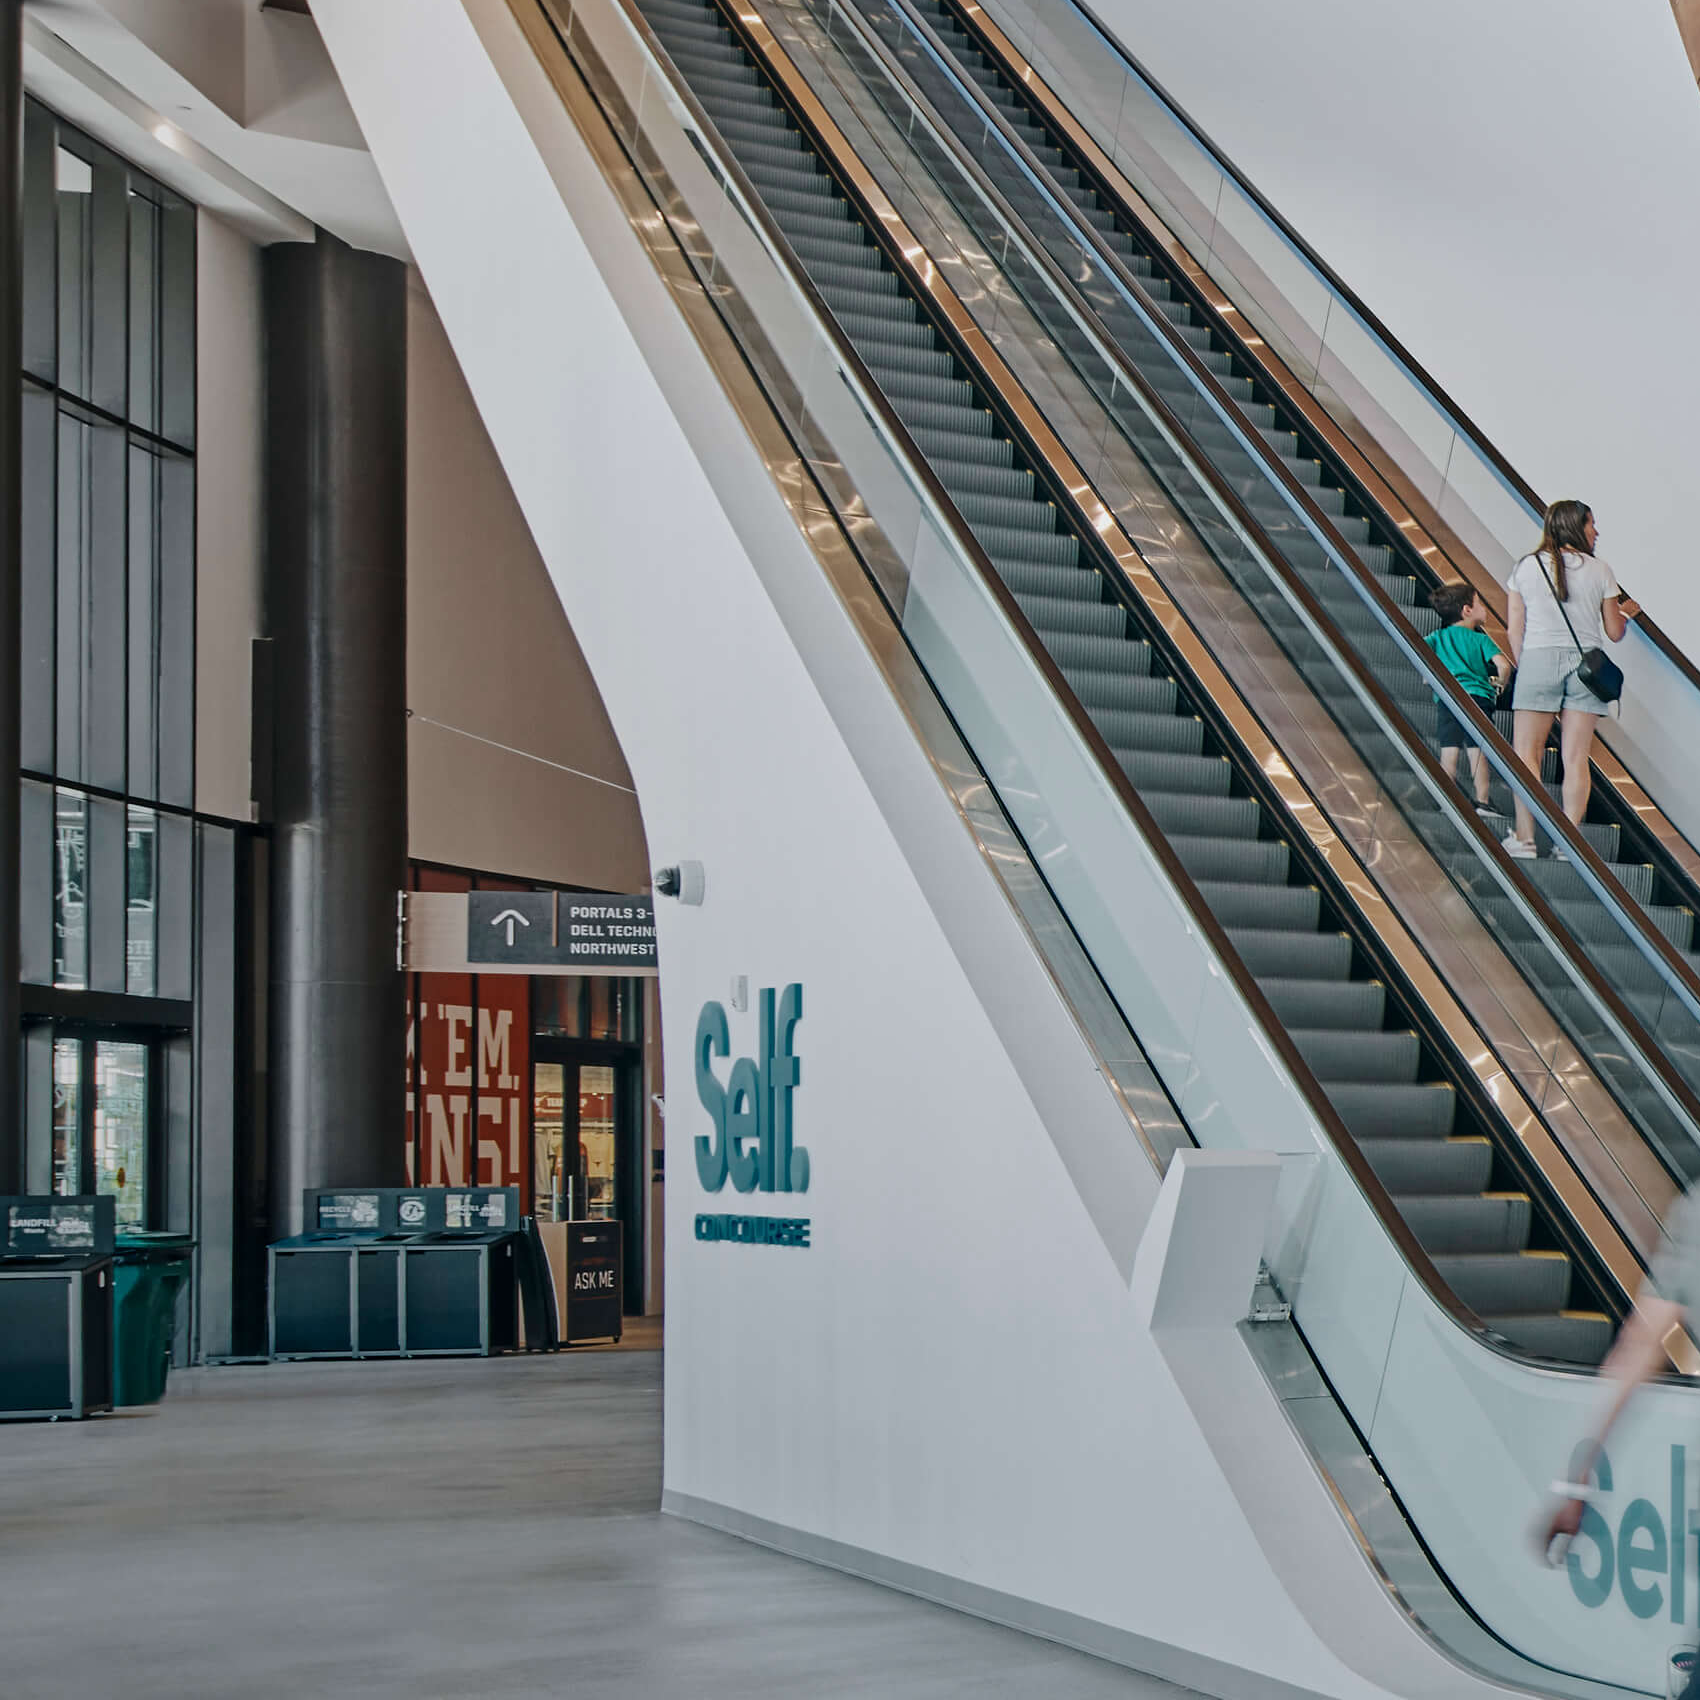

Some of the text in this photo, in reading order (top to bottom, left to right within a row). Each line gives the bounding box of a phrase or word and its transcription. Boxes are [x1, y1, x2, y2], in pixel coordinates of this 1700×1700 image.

[570, 906, 633, 919] PORTALS
[570, 925, 605, 936] DELL
[570, 942, 656, 955] NORTHWEST
[694, 982, 811, 1194] Self.
[695, 1213, 811, 1248] CONCOURSE
[574, 1269, 615, 1290] ASK ME
